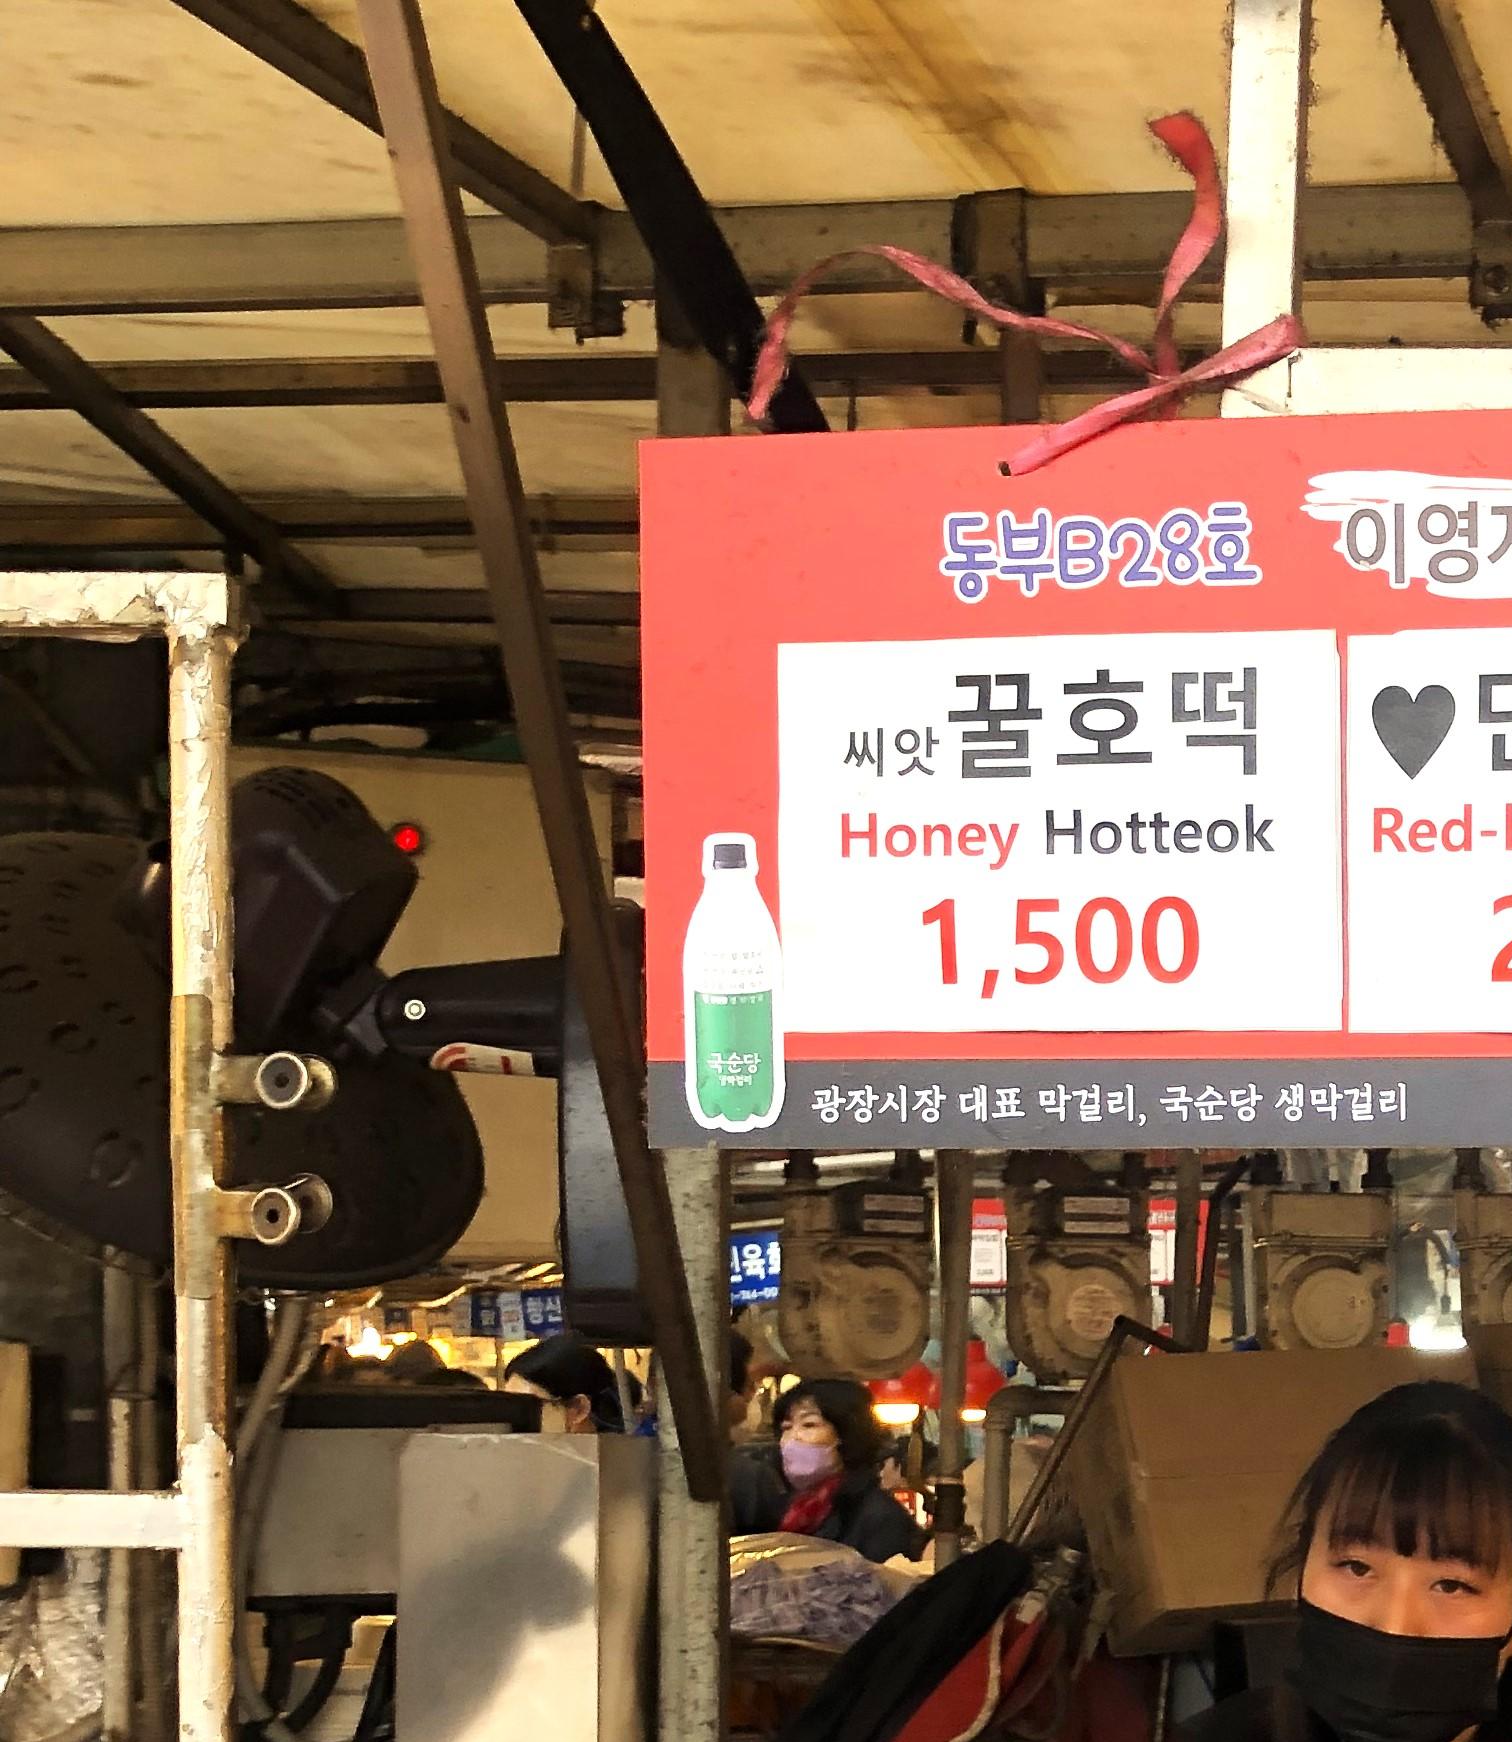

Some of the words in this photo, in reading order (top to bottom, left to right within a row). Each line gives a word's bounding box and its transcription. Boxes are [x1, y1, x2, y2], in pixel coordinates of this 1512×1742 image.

[943, 507, 1260, 598] 동부B28호
[841, 813, 1019, 870] Honey
[1046, 804, 1274, 854] Hotteok
[923, 896, 1199, 999] 1,500
[706, 1051, 762, 1079] 국순당
[811, 1084, 946, 1124] 광장시장
[959, 1084, 1026, 1123] 대표
[1039, 1084, 1147, 1126] 막걸리,
[1159, 1084, 1262, 1123] 국순당
[1274, 1084, 1408, 1124] 생막걸리
